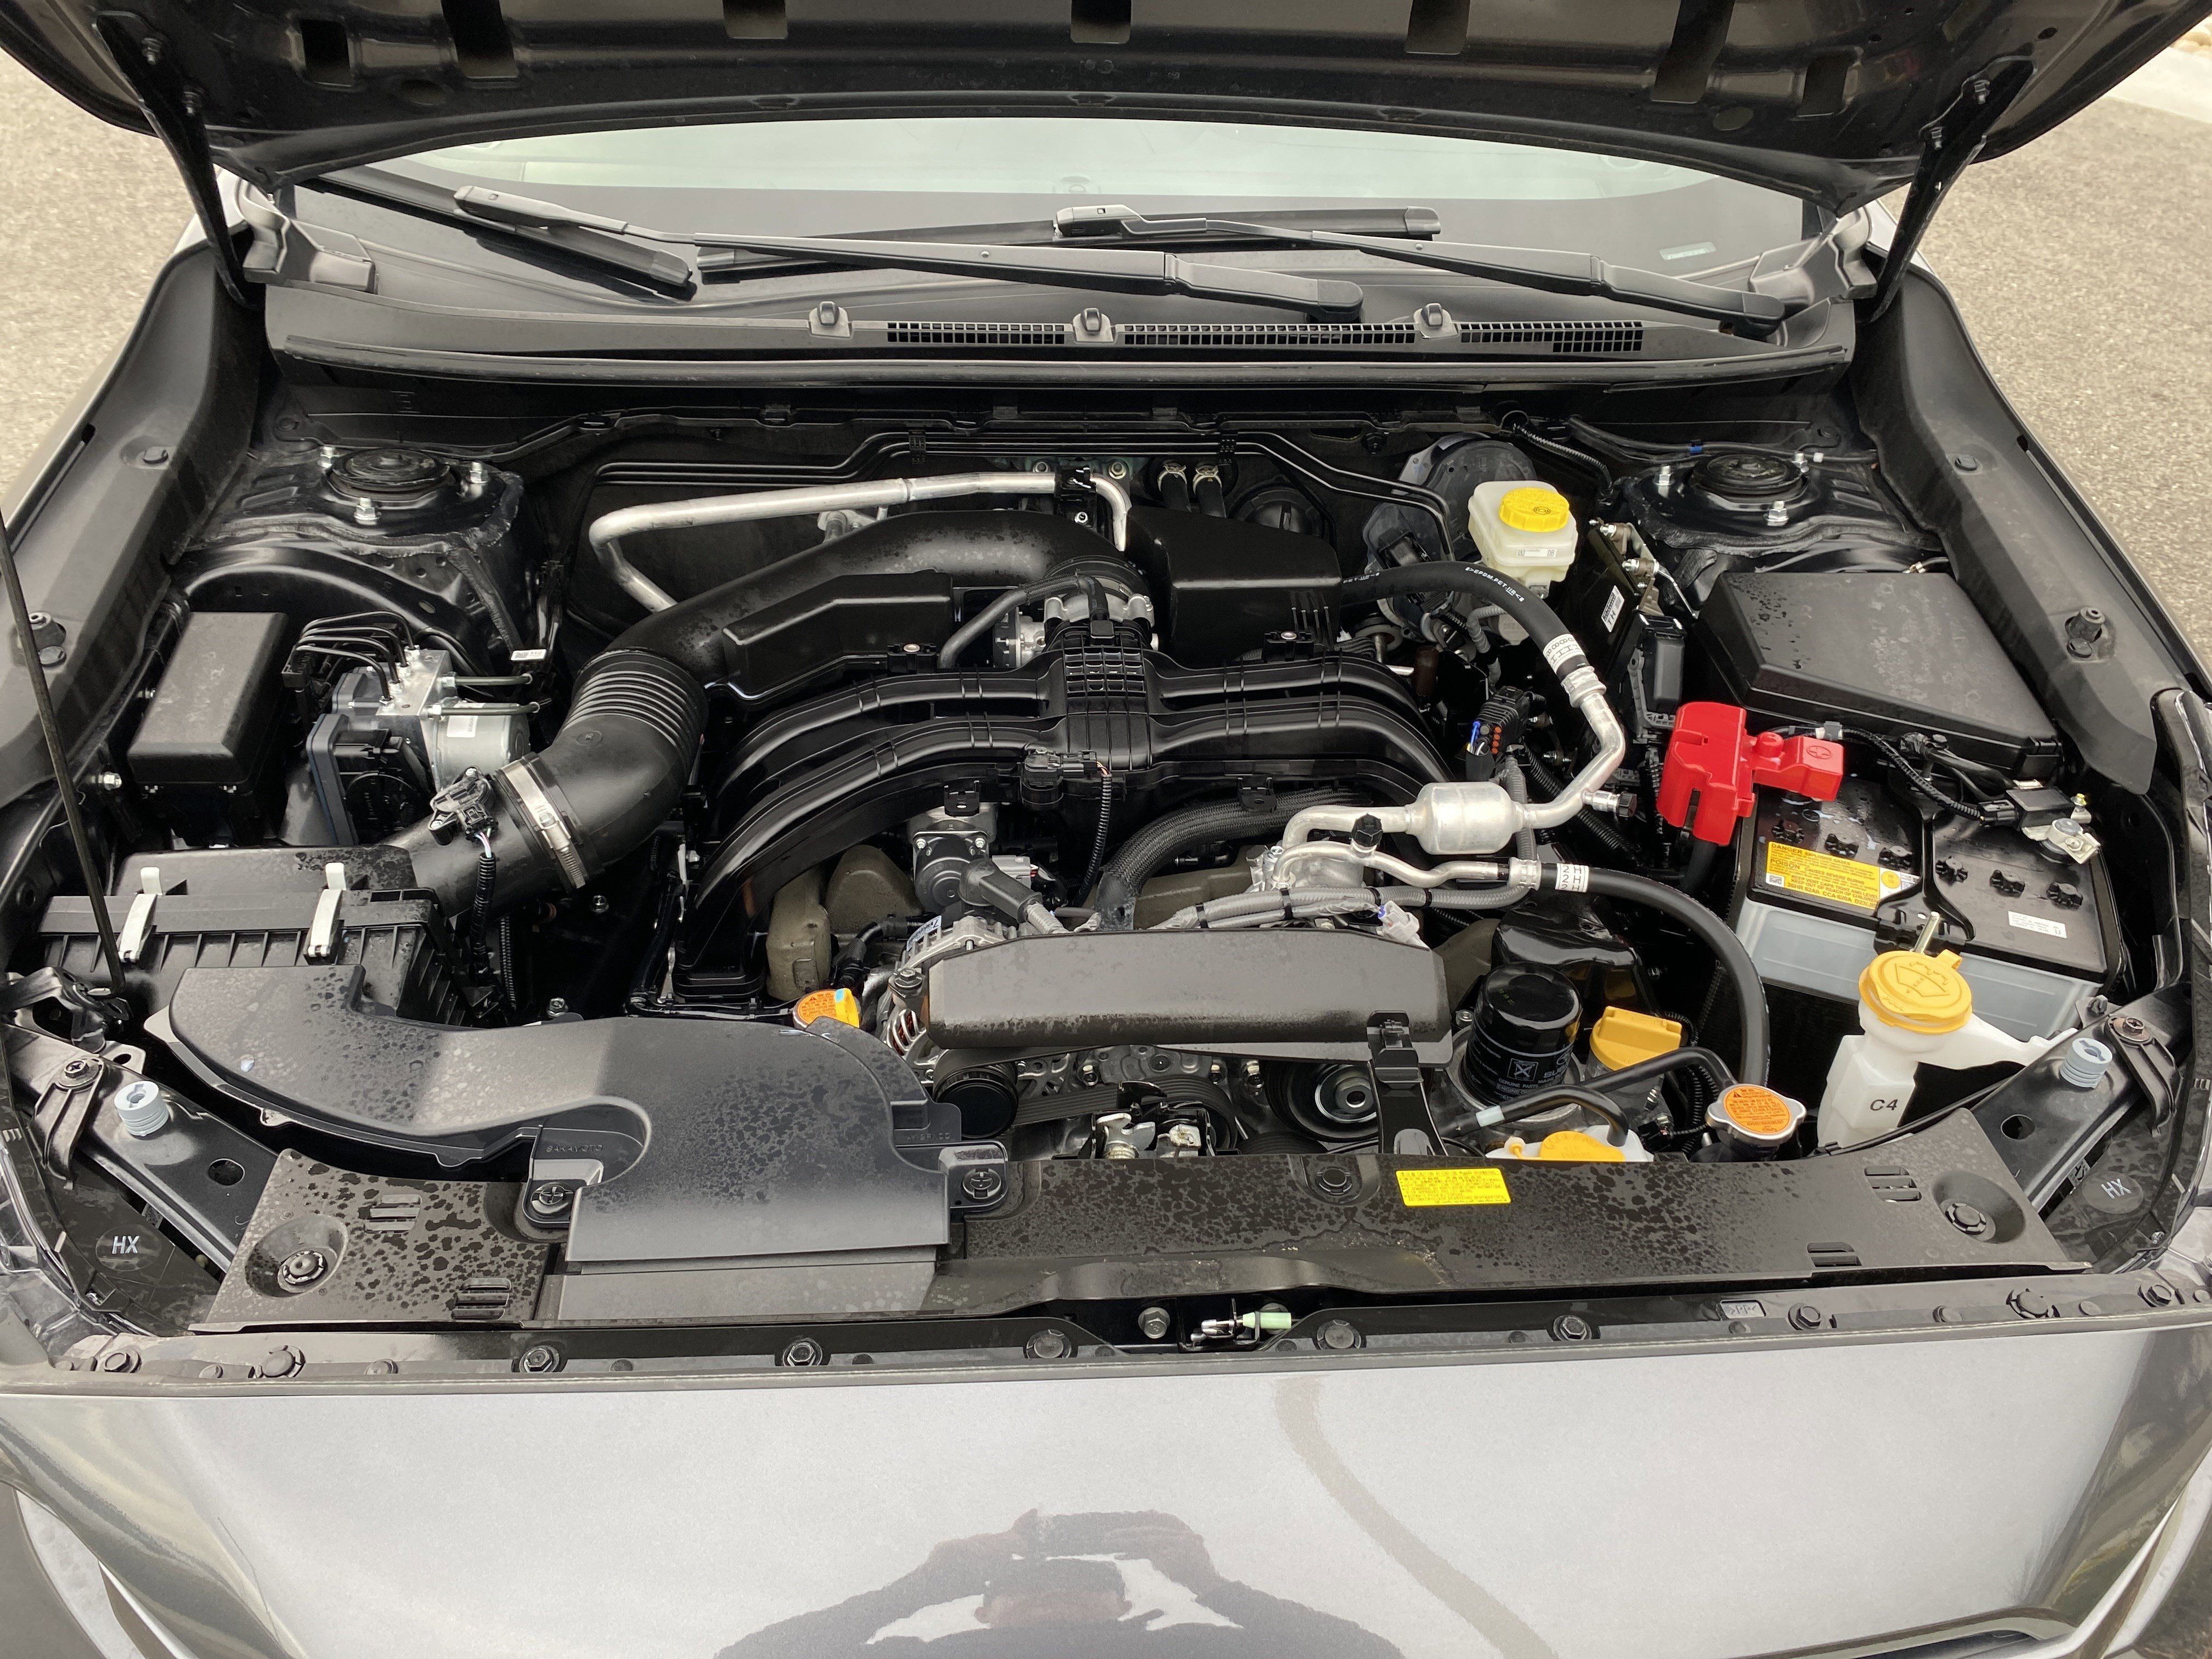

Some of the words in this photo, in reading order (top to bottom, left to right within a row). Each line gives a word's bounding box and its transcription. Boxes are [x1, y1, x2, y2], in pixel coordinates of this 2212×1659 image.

[1771, 843, 1803, 855] DANGER
[1770, 859, 1800, 870] POISON
[1562, 874, 1568, 883] 2
[1573, 875, 1581, 884] H
[1499, 1078, 1521, 1088] GENUINE
[1870, 1098, 1898, 1111] C4
[2101, 1178, 2132, 1199] HX
[112, 1235, 140, 1254] HX
